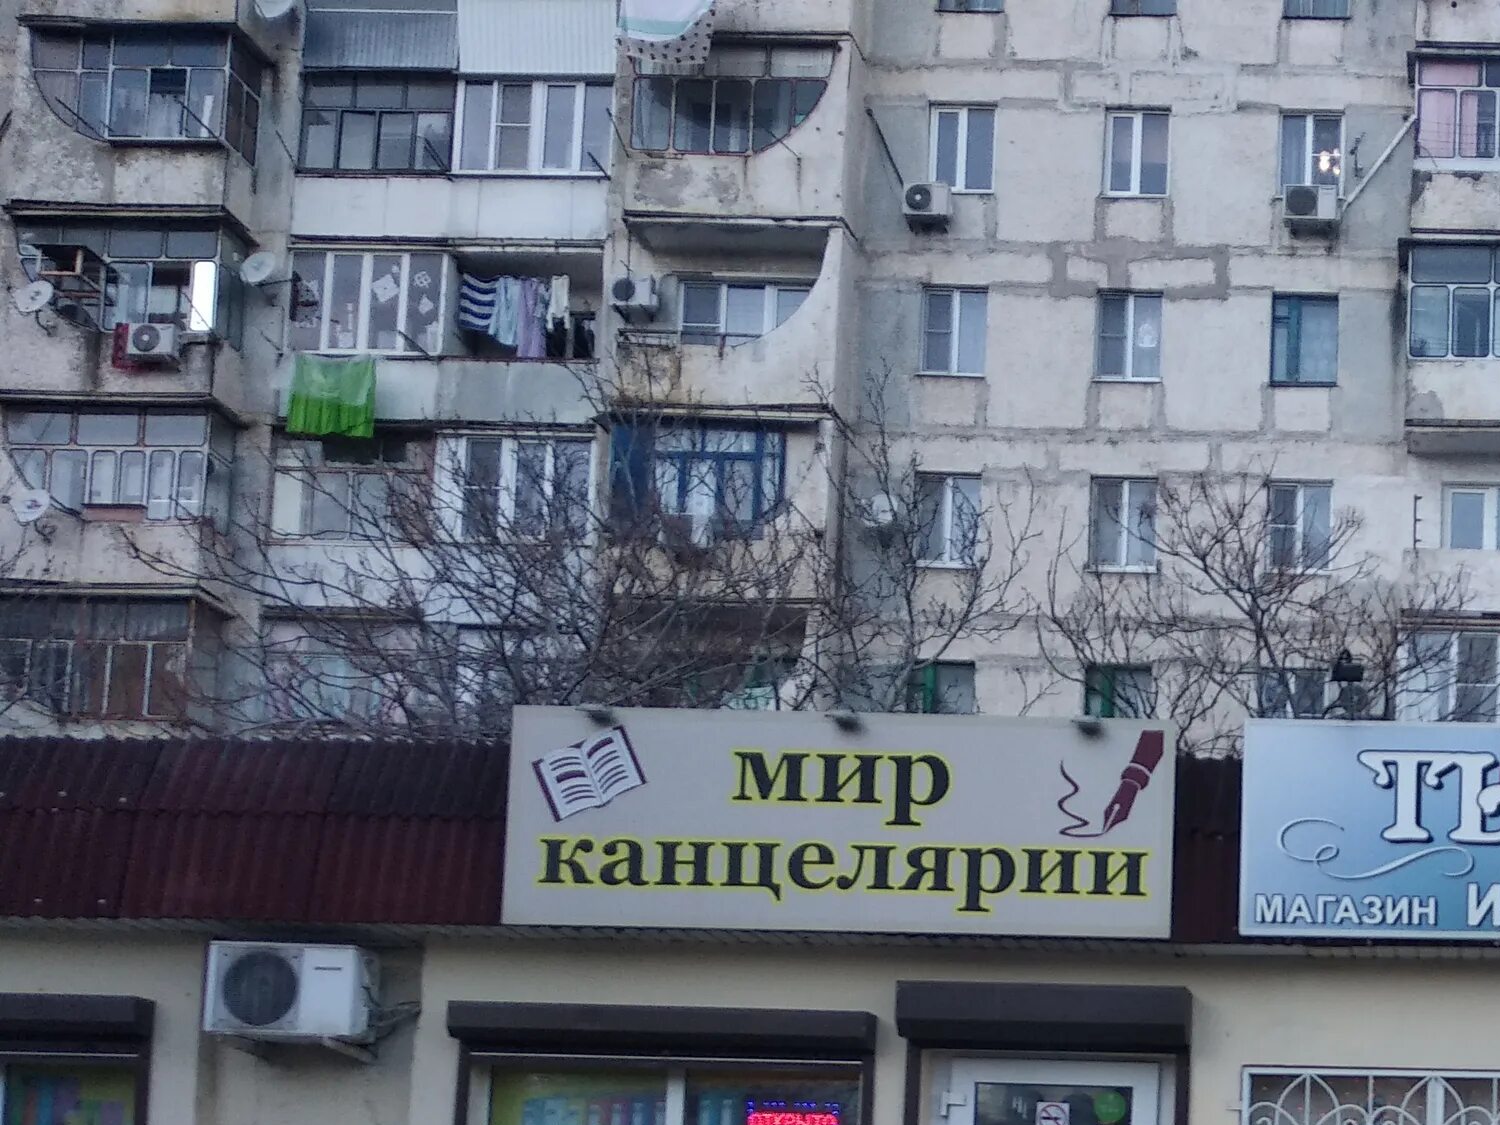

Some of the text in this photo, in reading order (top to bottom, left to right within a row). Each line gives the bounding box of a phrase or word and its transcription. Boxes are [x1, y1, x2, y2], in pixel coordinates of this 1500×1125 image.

[732, 750, 950, 826] мир
[538, 836, 1149, 912] канцелярии
[1254, 893, 1438, 926] МАГАЗИН
